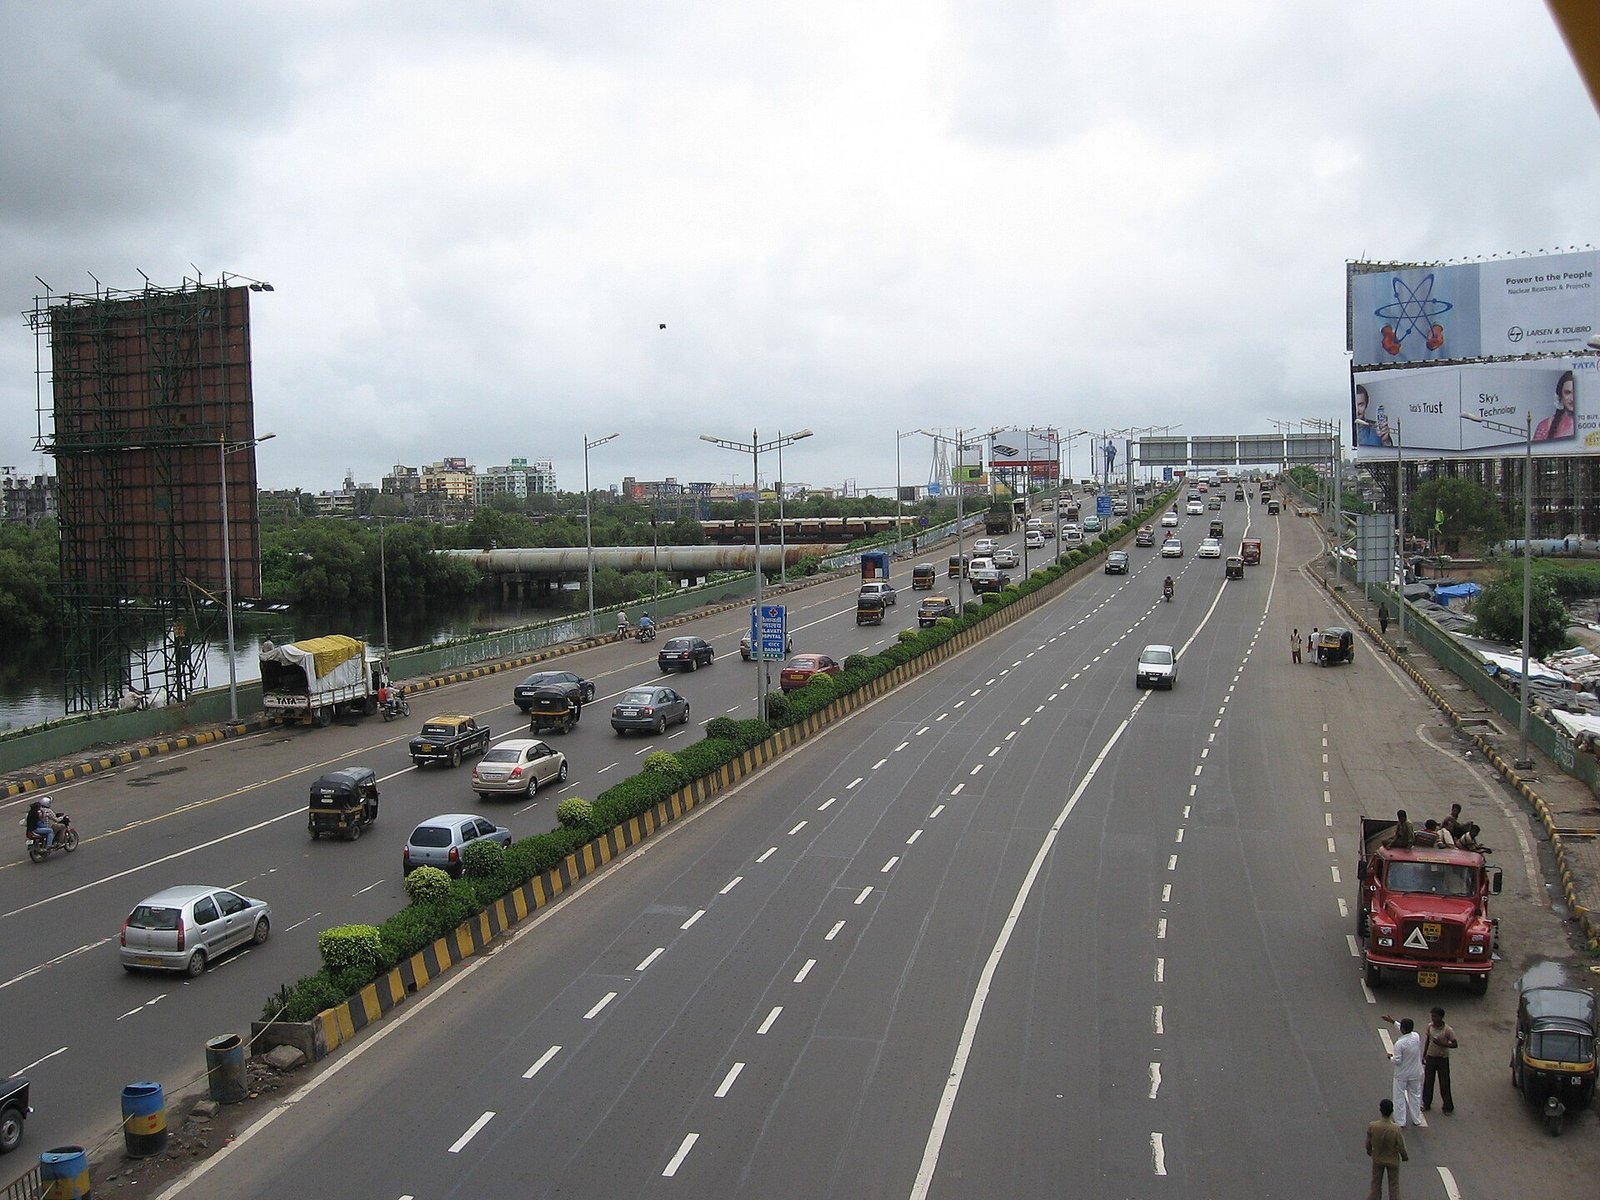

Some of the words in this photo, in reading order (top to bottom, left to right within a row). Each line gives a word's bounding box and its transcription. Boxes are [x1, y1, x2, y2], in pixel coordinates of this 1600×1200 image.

[1563, 270, 1593, 280] People
[1566, 282, 1590, 290] Projects
[1562, 325, 1592, 334] TOUBRO
[1479, 393, 1499, 404] Sky's
[1423, 401, 1443, 414] Trust
[1479, 406, 1516, 418] Technology
[1577, 421, 1597, 429] 6000
[276, 697, 297, 705] TATA
